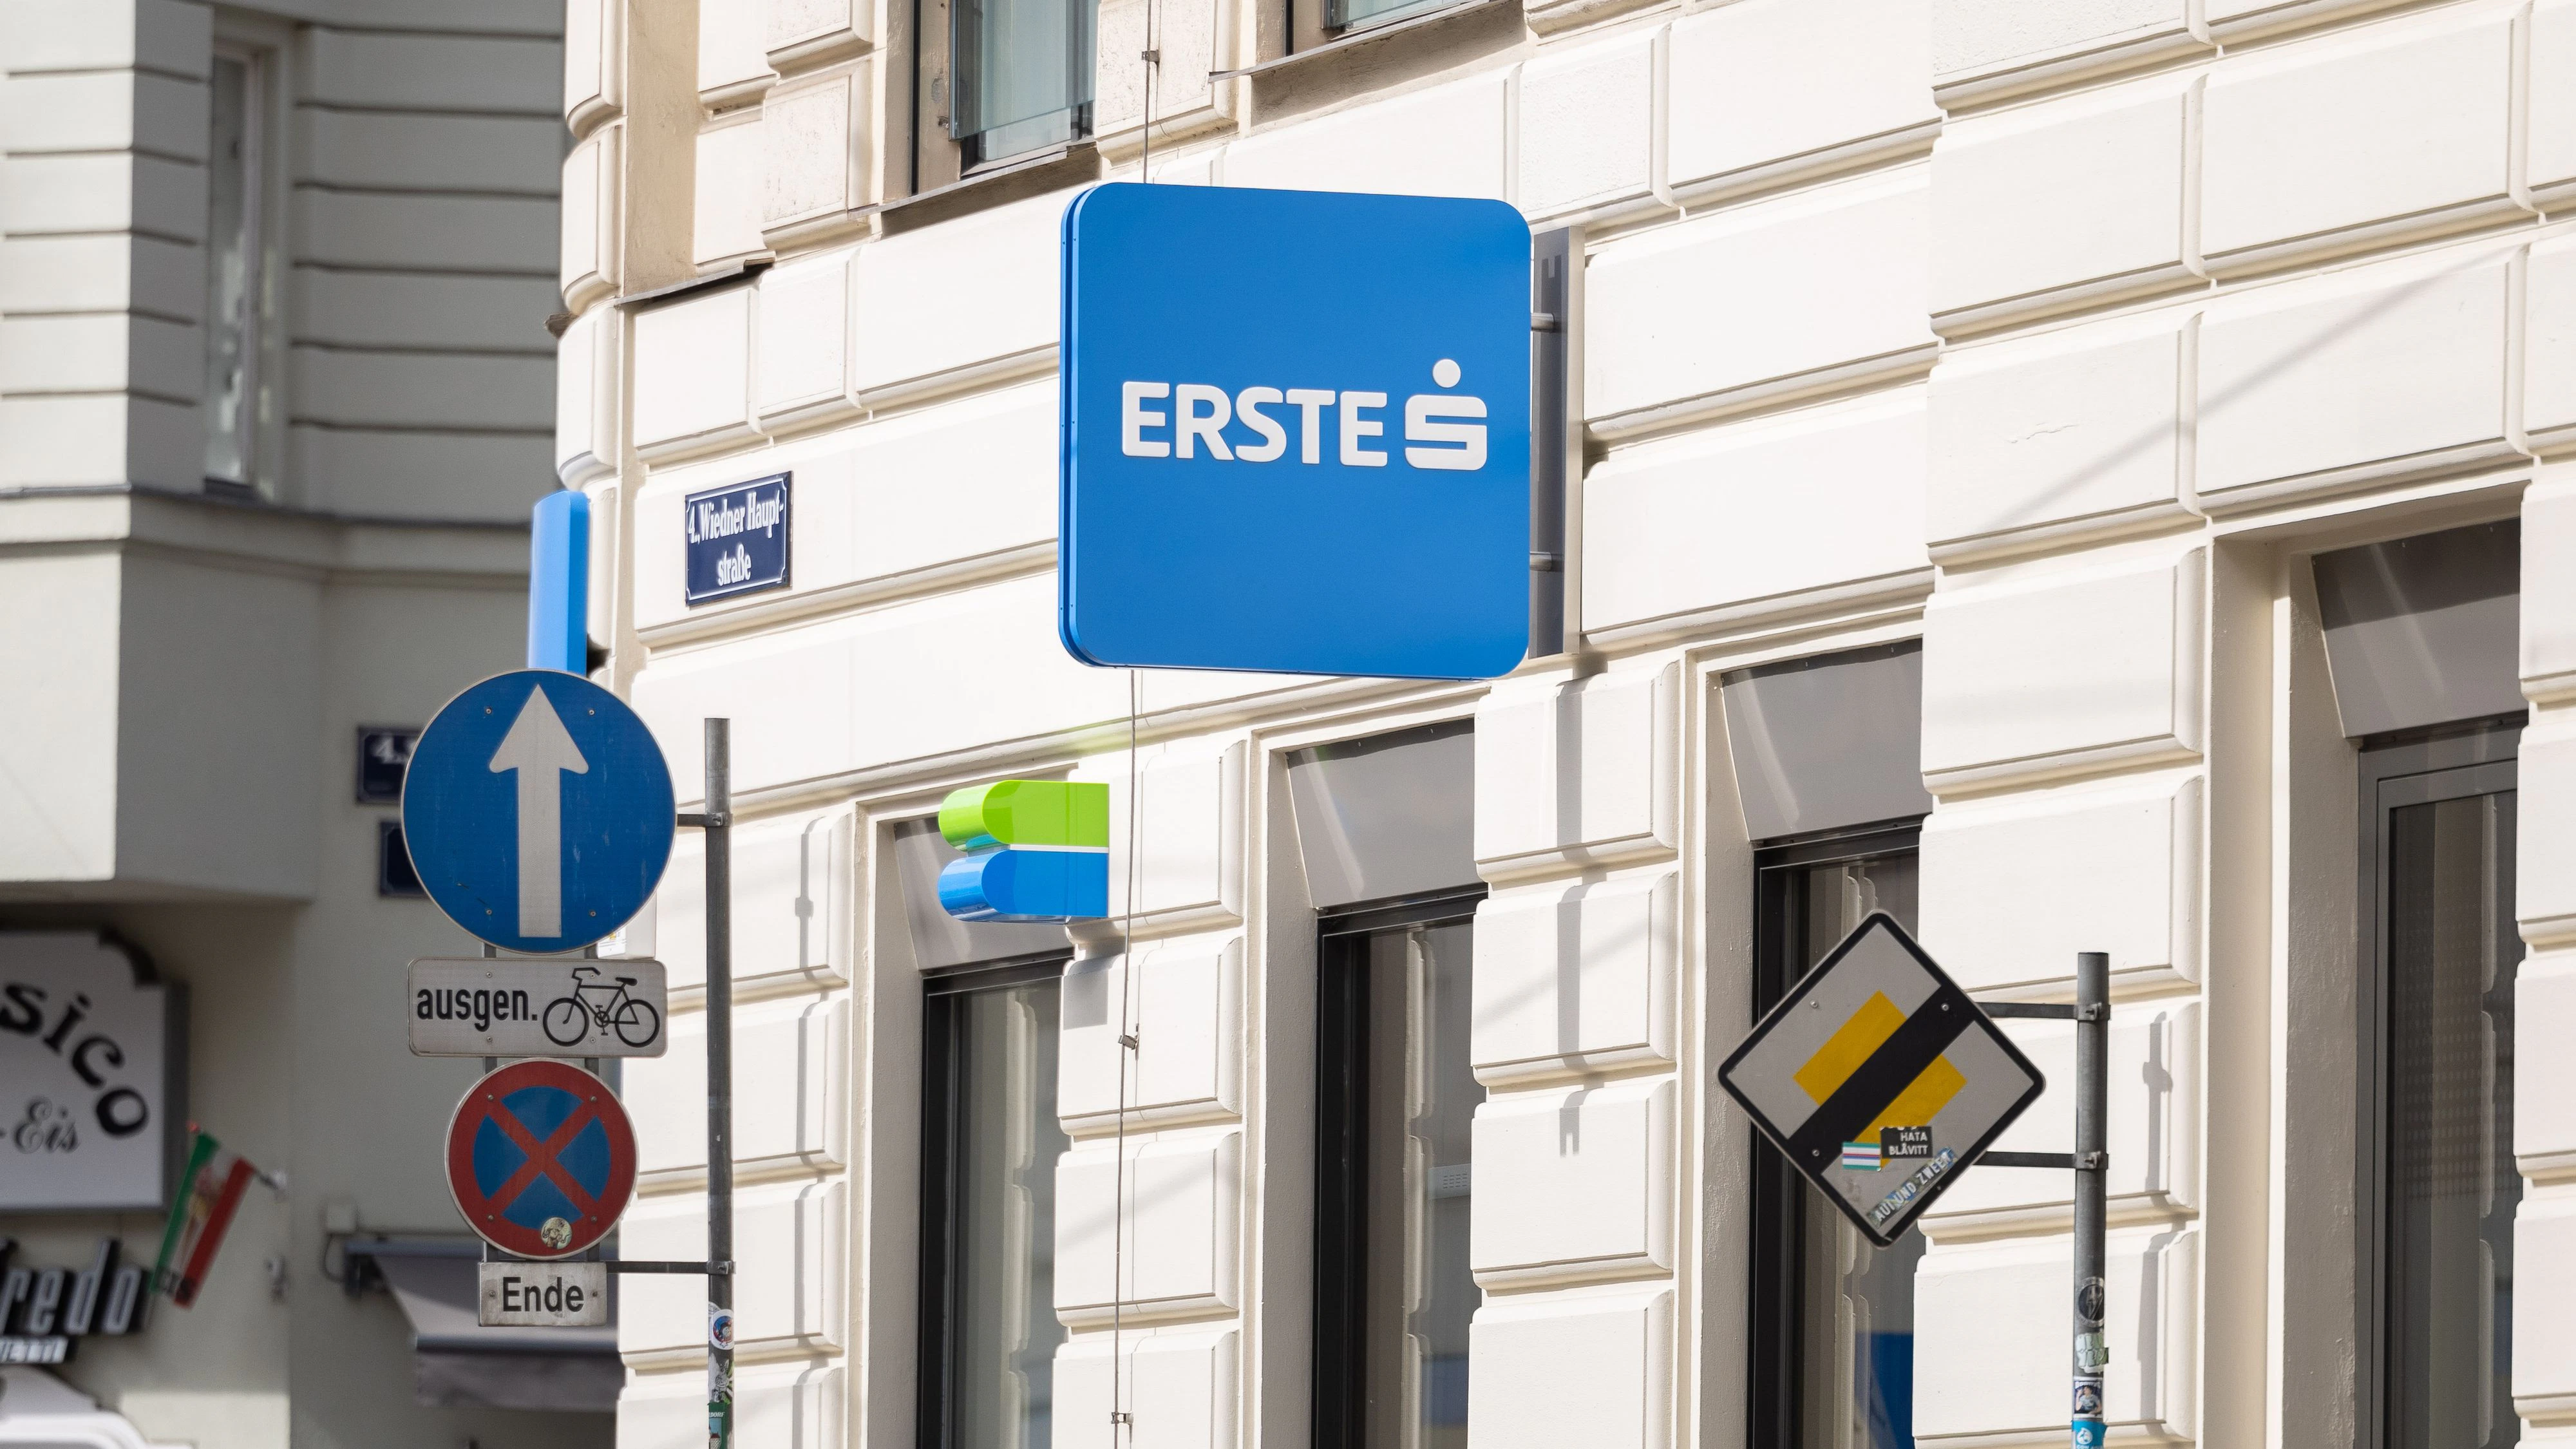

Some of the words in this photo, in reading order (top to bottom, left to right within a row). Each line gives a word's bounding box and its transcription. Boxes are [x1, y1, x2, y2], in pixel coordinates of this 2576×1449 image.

[1122, 381, 1388, 468] ERSTE
[746, 490, 784, 539] Haupt-
[717, 543, 752, 587] straße
[417, 987, 538, 1032] ausgen.
[1889, 1143, 1927, 1155] BLÅVITT
[1900, 1132, 1927, 1141] HATA
[1892, 1182, 1917, 1204] UND
[0, 1238, 143, 1335] redo
[502, 1276, 585, 1313] Ende
